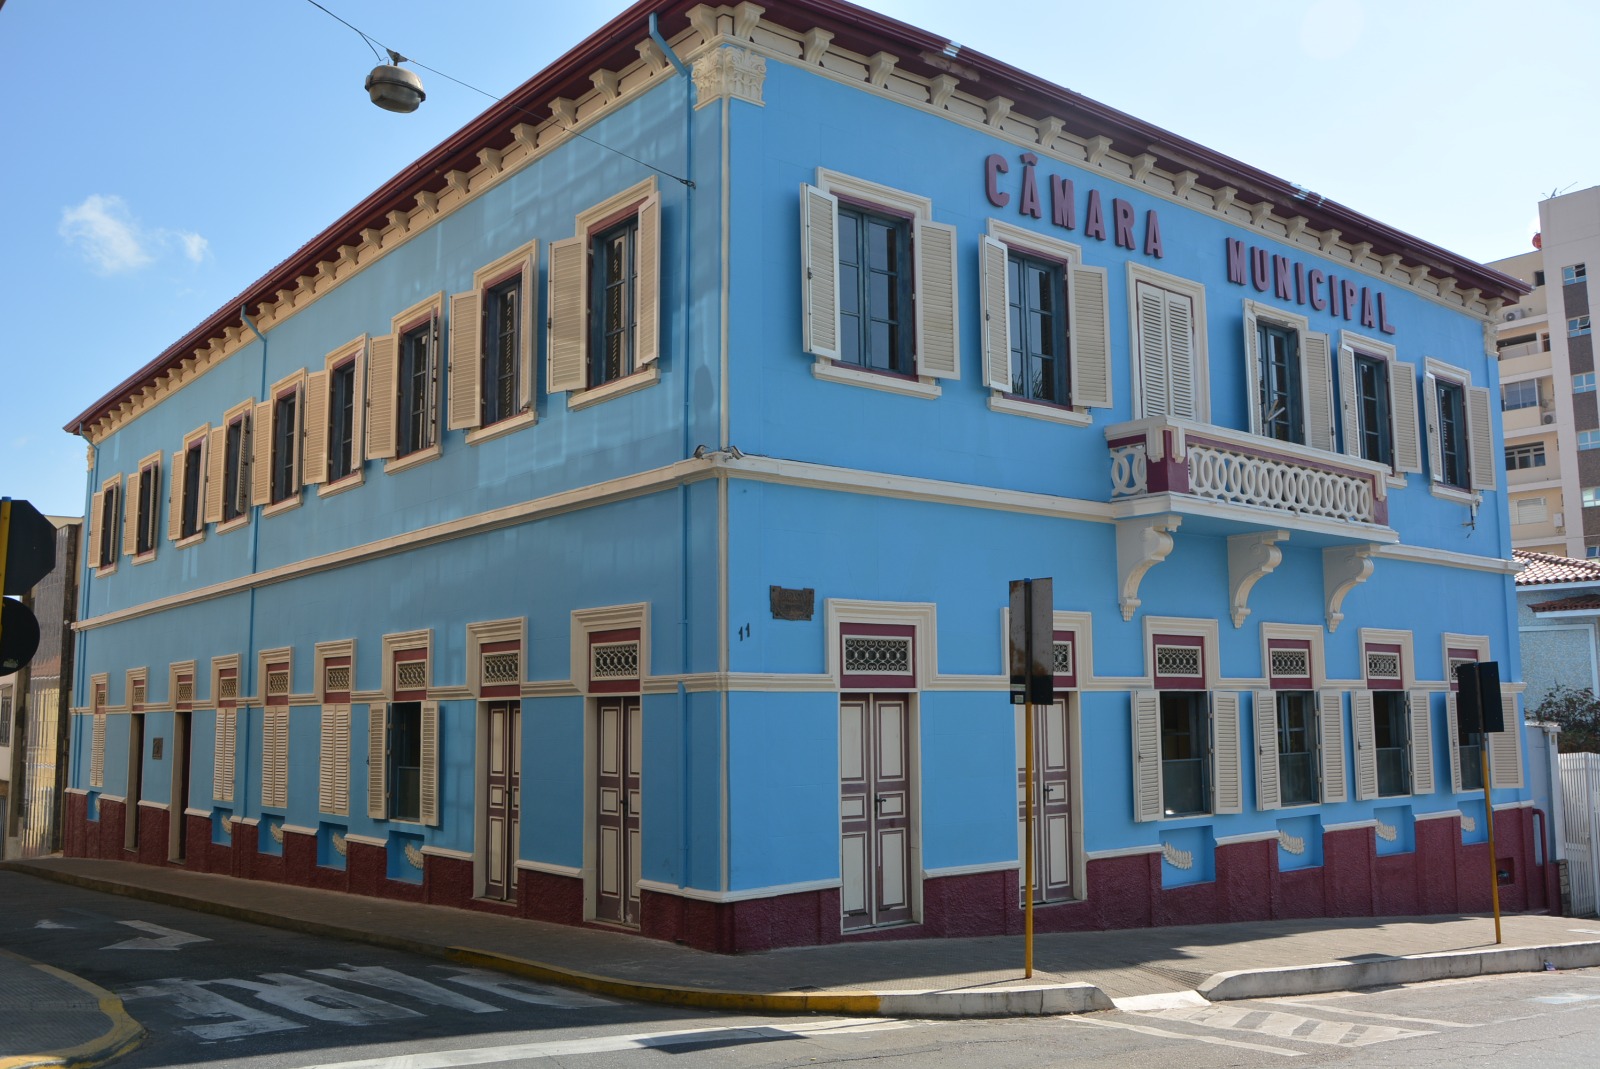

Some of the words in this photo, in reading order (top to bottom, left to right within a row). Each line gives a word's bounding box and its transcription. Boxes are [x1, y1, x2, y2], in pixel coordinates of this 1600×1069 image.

[985, 152, 1164, 259] CÂMARA
[1226, 237, 1396, 335] MUNICIPAL
[738, 622, 750, 641] 11
